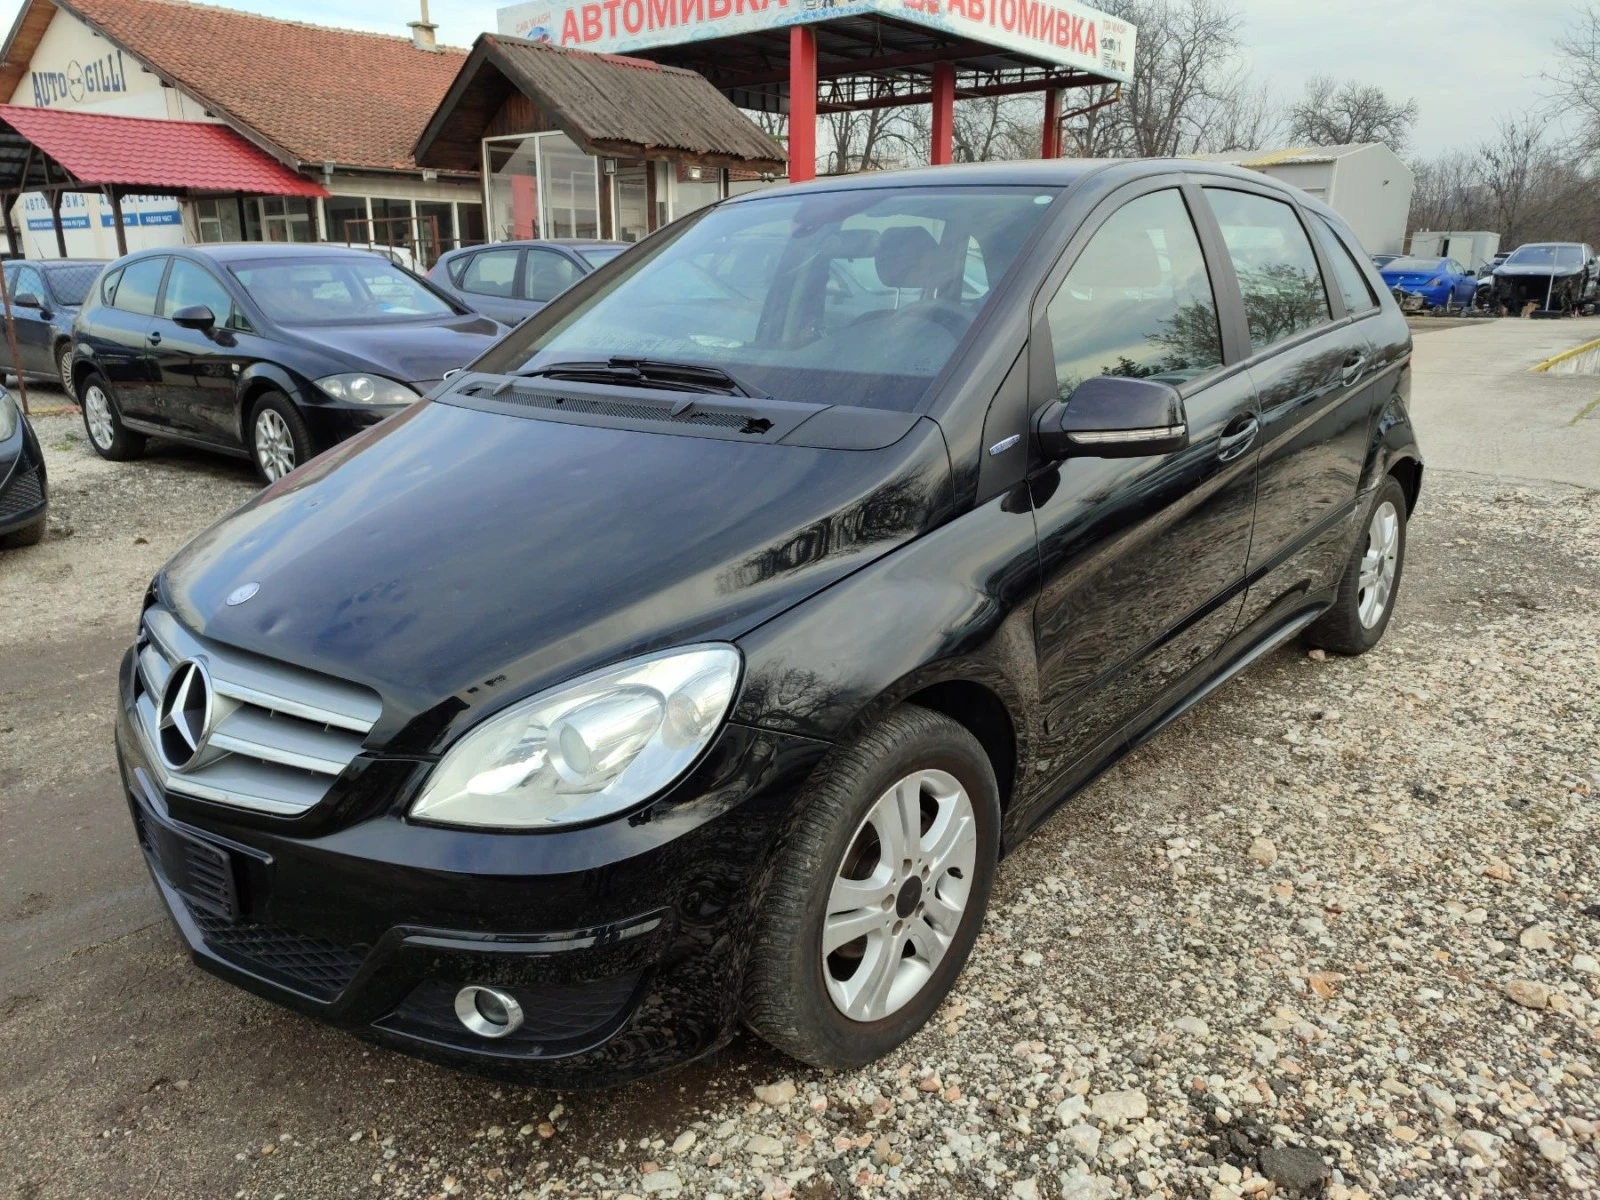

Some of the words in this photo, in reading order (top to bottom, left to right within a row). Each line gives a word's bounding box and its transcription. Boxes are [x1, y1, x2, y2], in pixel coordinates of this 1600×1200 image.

[561, 0, 788, 46] АВТОМИ
[32, 72, 67, 107] AUTO
[85, 50, 126, 92] GILLI
[25, 193, 85, 211] АВТОВИЗ
